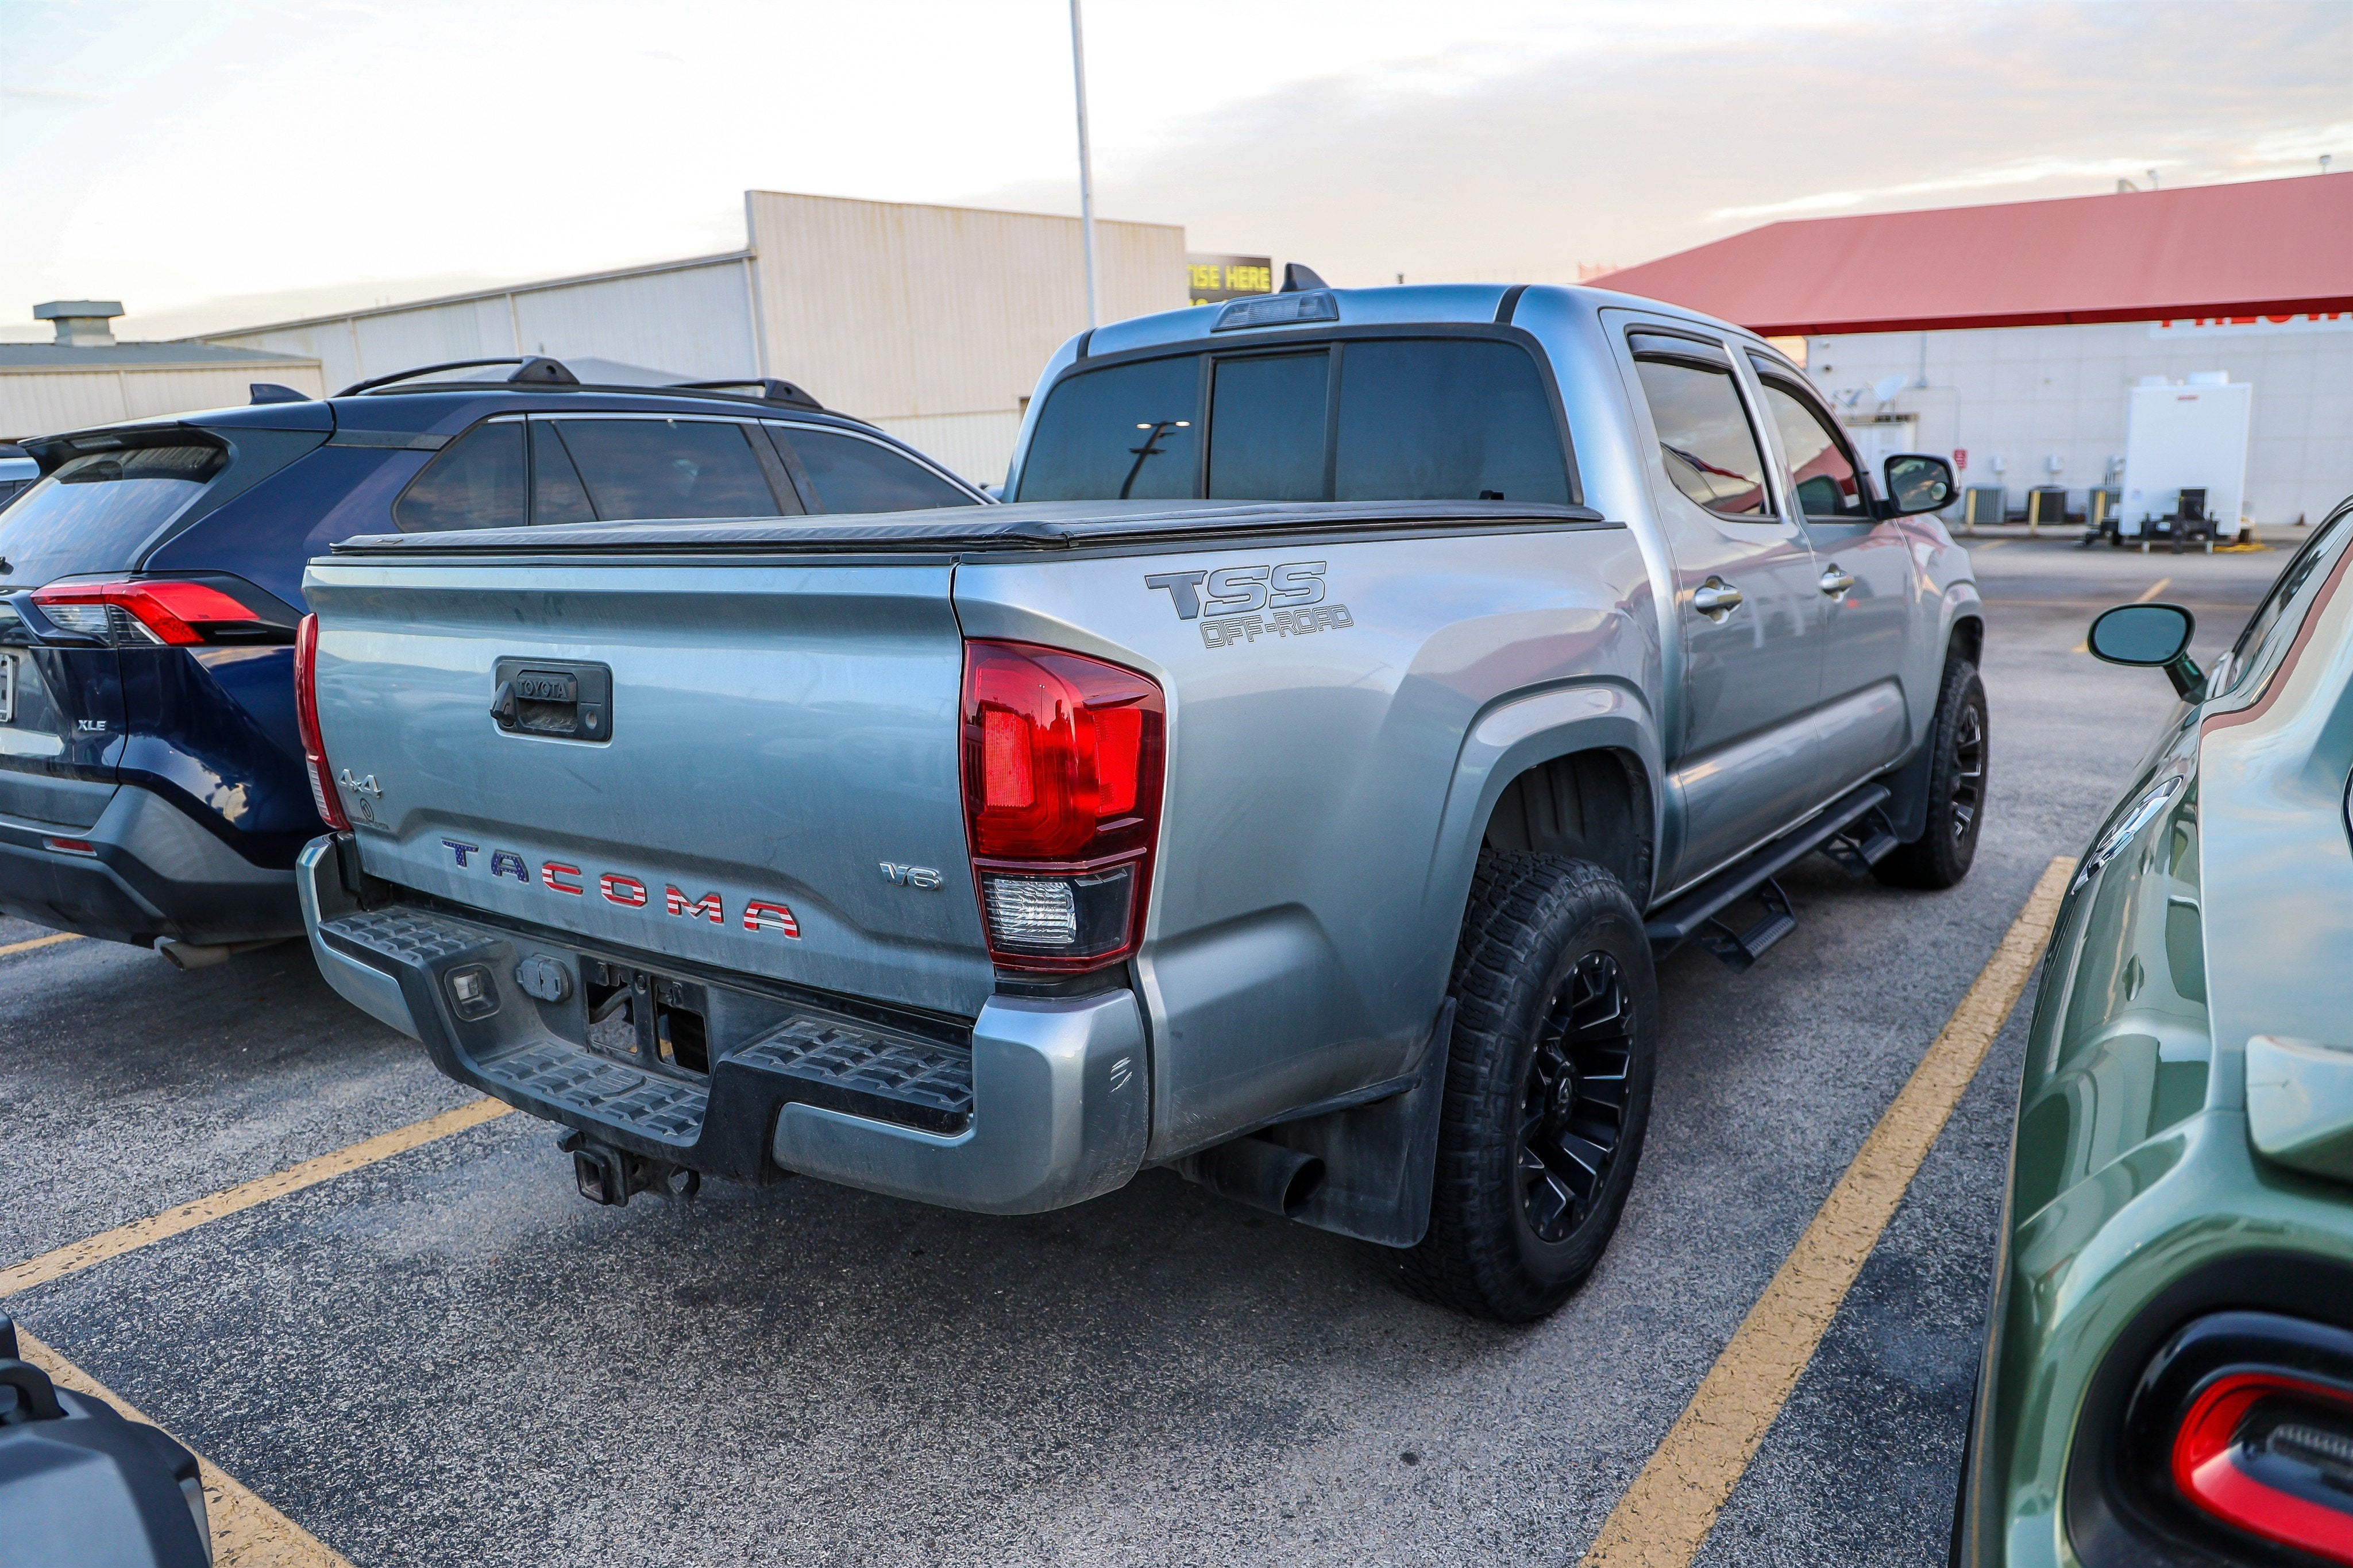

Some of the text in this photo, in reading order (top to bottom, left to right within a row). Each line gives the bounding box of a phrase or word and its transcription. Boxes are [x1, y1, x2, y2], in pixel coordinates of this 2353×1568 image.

[1225, 265, 1271, 292] HERE
[1144, 560, 1327, 620] TSS
[1199, 603, 1355, 649] OFF-ROAD
[517, 678, 568, 698] TOYOTA
[78, 719, 107, 732] XLE
[441, 837, 801, 940] TACOMA
[879, 861, 943, 891] V6
